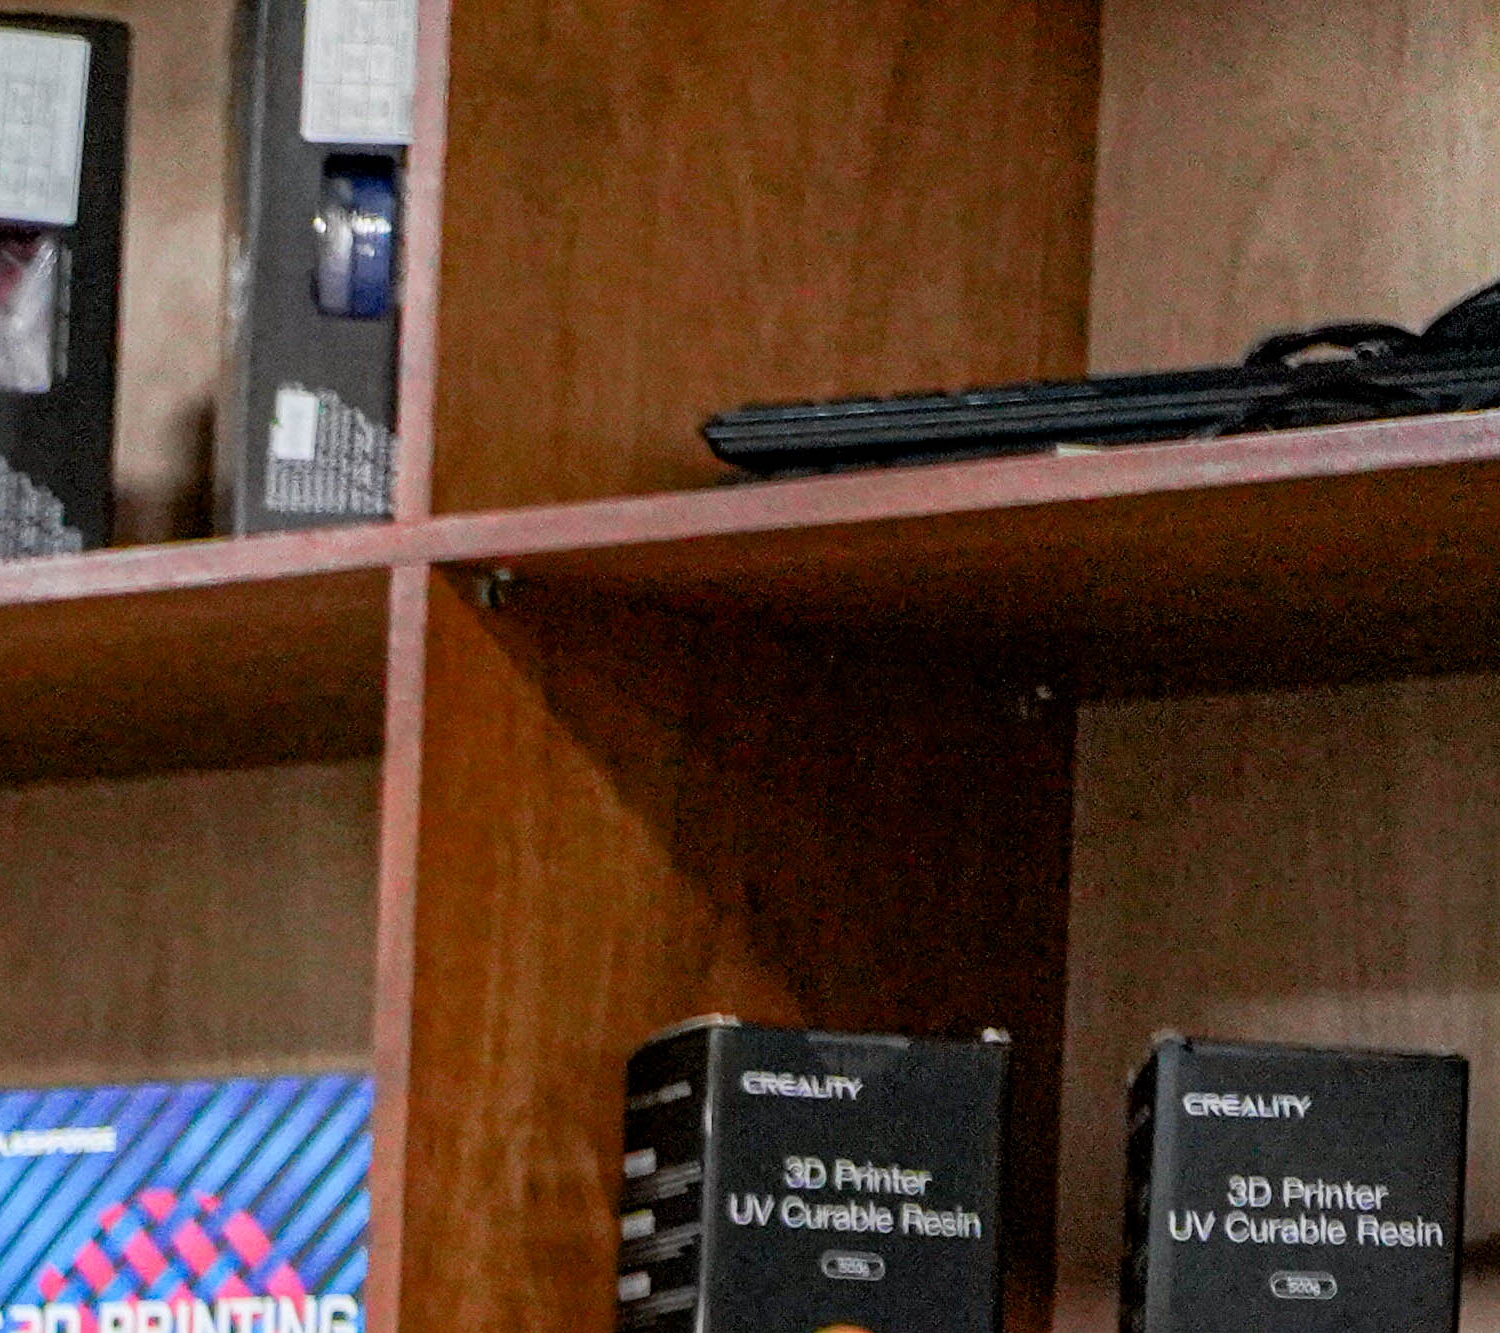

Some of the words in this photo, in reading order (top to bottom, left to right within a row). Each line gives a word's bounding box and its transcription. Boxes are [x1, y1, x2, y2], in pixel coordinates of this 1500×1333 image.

[742, 1070, 863, 1100] CREALITY
[1183, 1091, 1312, 1118] CREALITY
[785, 1155, 827, 1190] 3D
[835, 1158, 932, 1196] Printer
[1227, 1175, 1272, 1208] 3D
[1283, 1176, 1389, 1211] Printer
[729, 1192, 775, 1227] UV
[781, 1195, 893, 1234] Curable
[901, 1201, 982, 1239] Resin
[1169, 1209, 1216, 1242] UV
[1225, 1209, 1347, 1245] Curable
[1357, 1213, 1443, 1248] Resin
